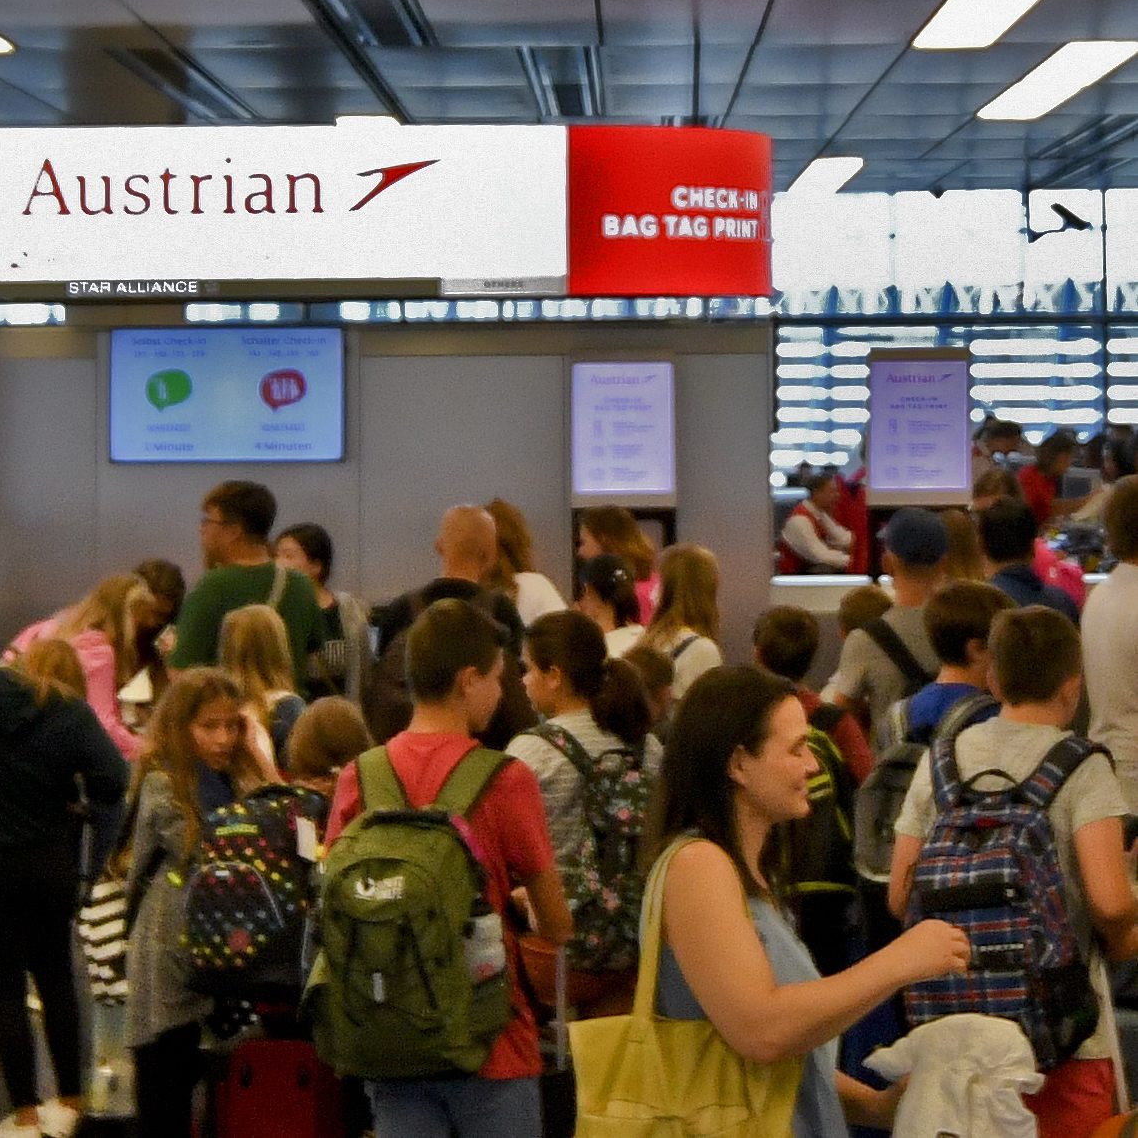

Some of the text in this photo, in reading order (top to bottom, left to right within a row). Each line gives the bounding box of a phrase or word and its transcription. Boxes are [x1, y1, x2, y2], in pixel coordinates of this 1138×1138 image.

[22, 157, 325, 215] Austrian
[673, 186, 758, 209] CHECK-IN
[603, 215, 758, 240] BAG TAG PRINT
[68, 281, 112, 294] STAR
[116, 279, 199, 294] ALLIANCE
[886, 373, 936, 383] Austrian
